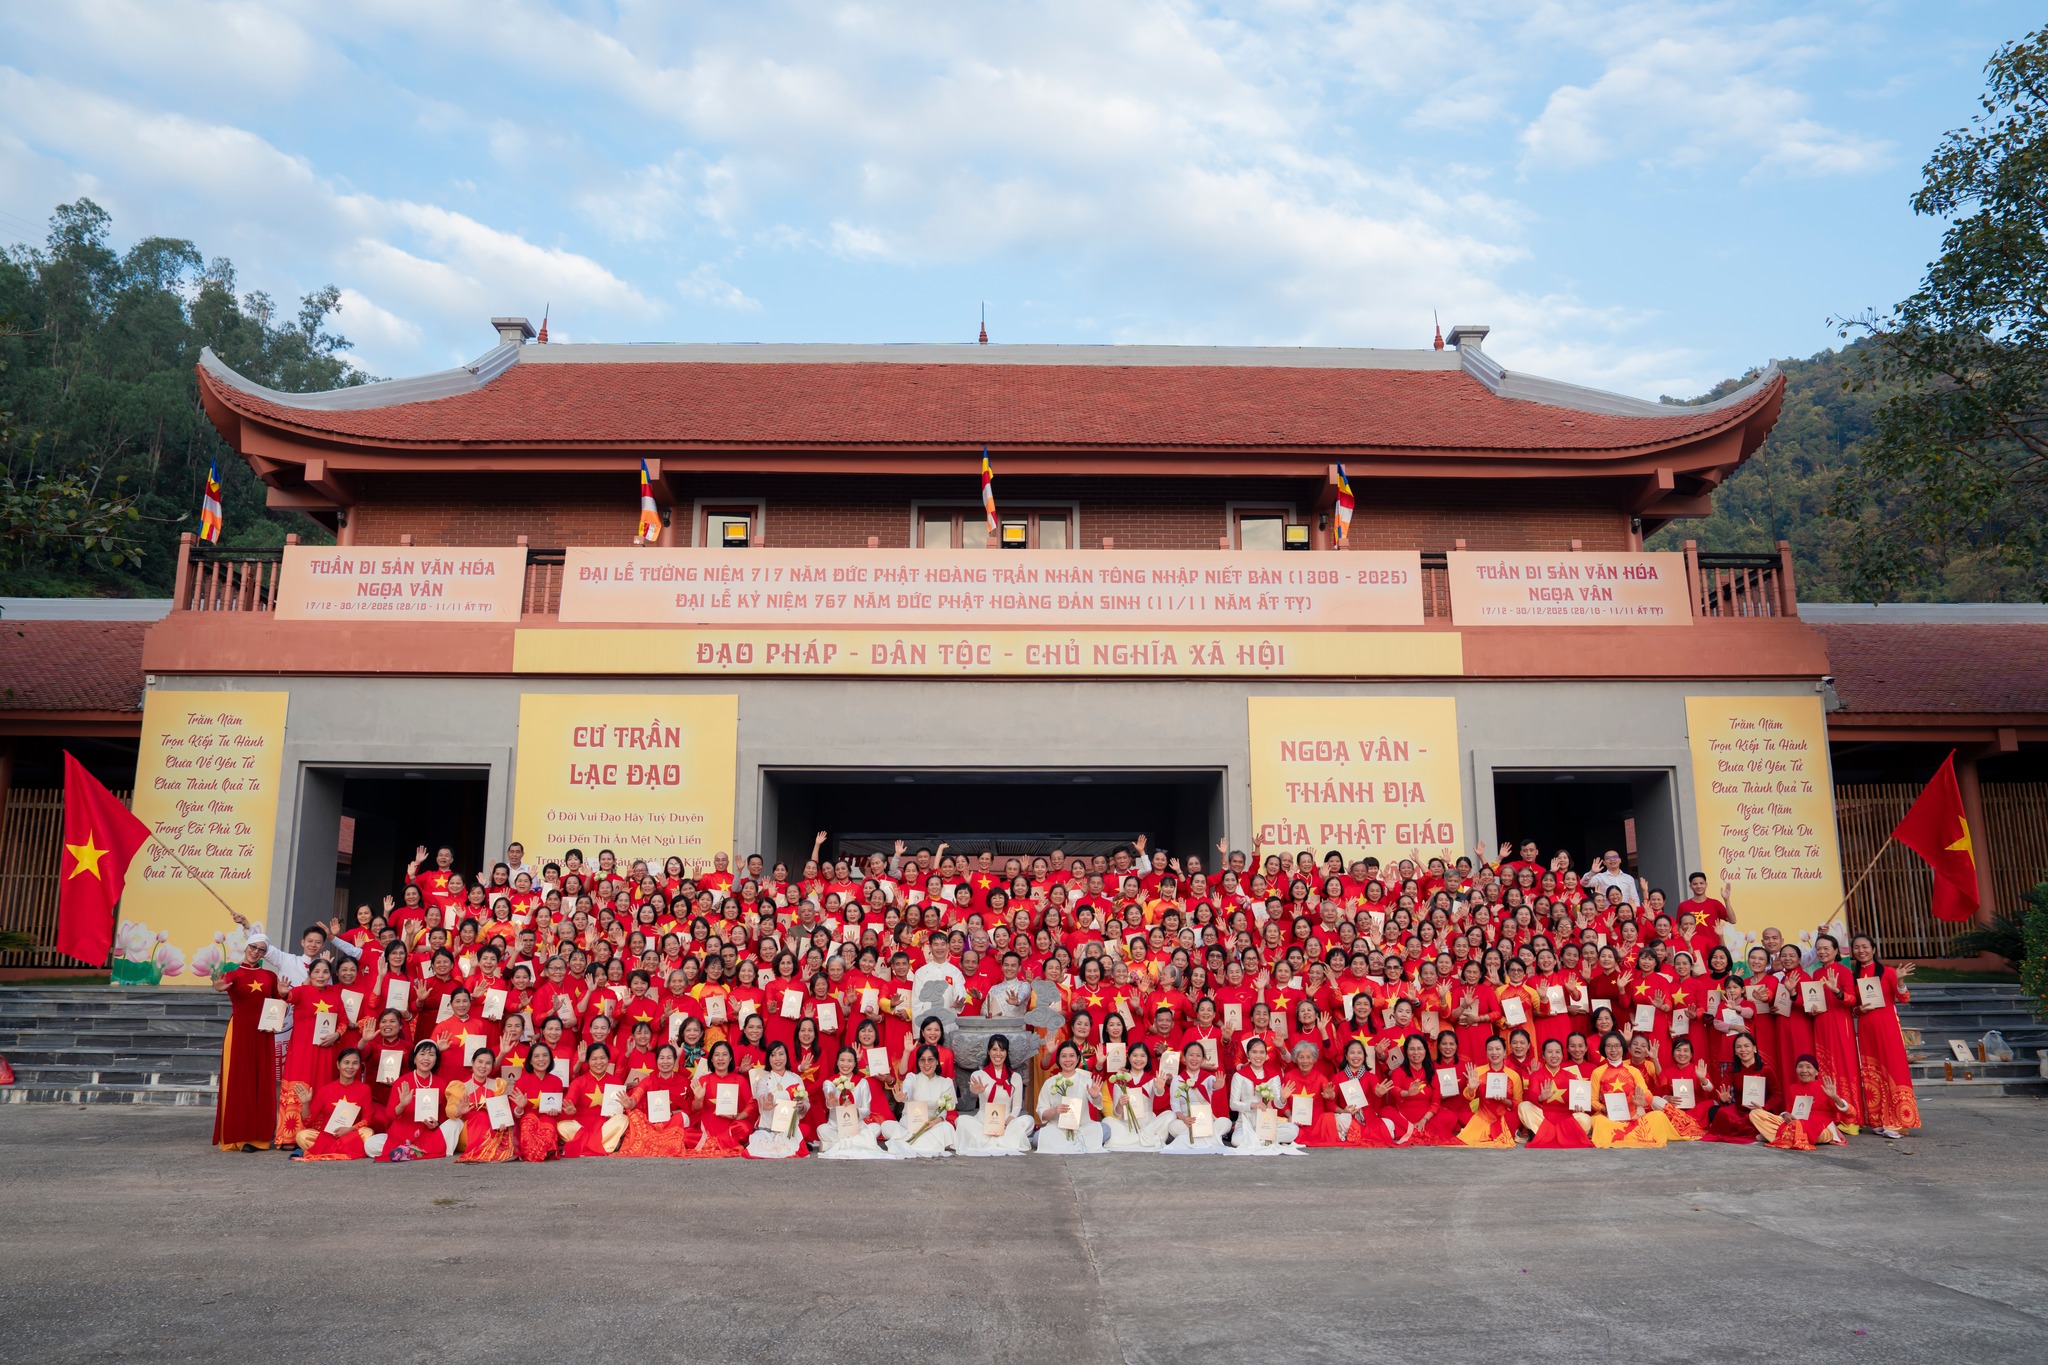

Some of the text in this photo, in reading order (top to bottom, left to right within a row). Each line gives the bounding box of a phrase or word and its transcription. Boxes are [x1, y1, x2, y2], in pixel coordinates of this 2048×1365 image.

[310, 555, 495, 575] TUẦN DI SẢN VĂN HÓA
[579, 567, 608, 584] ĐẠI
[614, 561, 634, 581] LỄ
[640, 563, 697, 581] TƯỞNG
[703, 564, 744, 585] NIỆM
[752, 568, 783, 582] 717
[790, 565, 827, 582] NĂM
[832, 565, 867, 582] ĐỨC
[874, 565, 920, 586] PHẬT
[924, 565, 987, 583] HOÀNG
[992, 563, 1038, 584] TRẦN
[1045, 566, 1093, 583] NHÂN
[1099, 566, 1146, 584] TÔNG
[1152, 567, 1199, 587] NHẬP
[1205, 565, 1242, 584] NIẾT
[1248, 567, 1282, 584] BÀN
[1289, 570, 1339, 584] (1308
[1358, 570, 1407, 584] 2025)
[1476, 560, 1658, 580] TUẦN DI SẢN VĂN HÓA
[357, 580, 443, 600] NGỌA VÂN
[1528, 584, 1613, 604] NGỌA VÂN
[675, 588, 1311, 613] ĐẠI LỄ KỶ NIỆM 767 NĂM ĐỨC PHẬT HOÀNG ĐẢN SINH (11/11 NĂM ẤT TỴ)
[696, 643, 753, 669] ĐẠO
[766, 638, 837, 664] PHÁP
[871, 639, 926, 665] DÂN
[938, 639, 991, 670] TỘC
[1026, 638, 1080, 665] CHỦ
[1093, 640, 1178, 665] NGHĨA
[1188, 640, 1225, 665] XÃ
[1236, 640, 1284, 670] HỘI
[187, 713, 242, 727] Trăm Năm
[1729, 717, 1783, 732] Trăm Năm
[161, 733, 264, 750] Trọn Kiếp Tu Hành
[573, 718, 680, 750] CƯ TRẦN
[1281, 740, 1350, 766] NGOẠ
[1358, 736, 1409, 761] VÂN
[1708, 738, 1807, 754] Trọn Kiếp Tu Hành
[165, 754, 192, 768] Chưa
[214, 756, 237, 771] Yên
[1718, 759, 1744, 773] Chưa
[1764, 759, 1786, 774] Yên
[154, 776, 260, 793] Chưa Thành Quả Tu
[570, 764, 680, 790] LẠC ĐẠO
[1286, 777, 1425, 808] THÁNH ĐỊA
[1712, 780, 1813, 795] Chưa Thành Quả Tu
[175, 799, 234, 818] Ngàn Năm
[1737, 802, 1792, 821] Ngàn Năm
[154, 821, 186, 840] Trong
[1260, 818, 1454, 850] CỦA PHẬT GIÁO
[1721, 824, 1750, 843] Trong
[205, 843, 233, 857] Chưa
[1718, 846, 1745, 865] Ngọa
[1774, 844, 1801, 858] Chưa
[143, 865, 167, 881] Quả
[1720, 867, 1741, 882] Quả
[1761, 866, 1787, 880] Chưa
